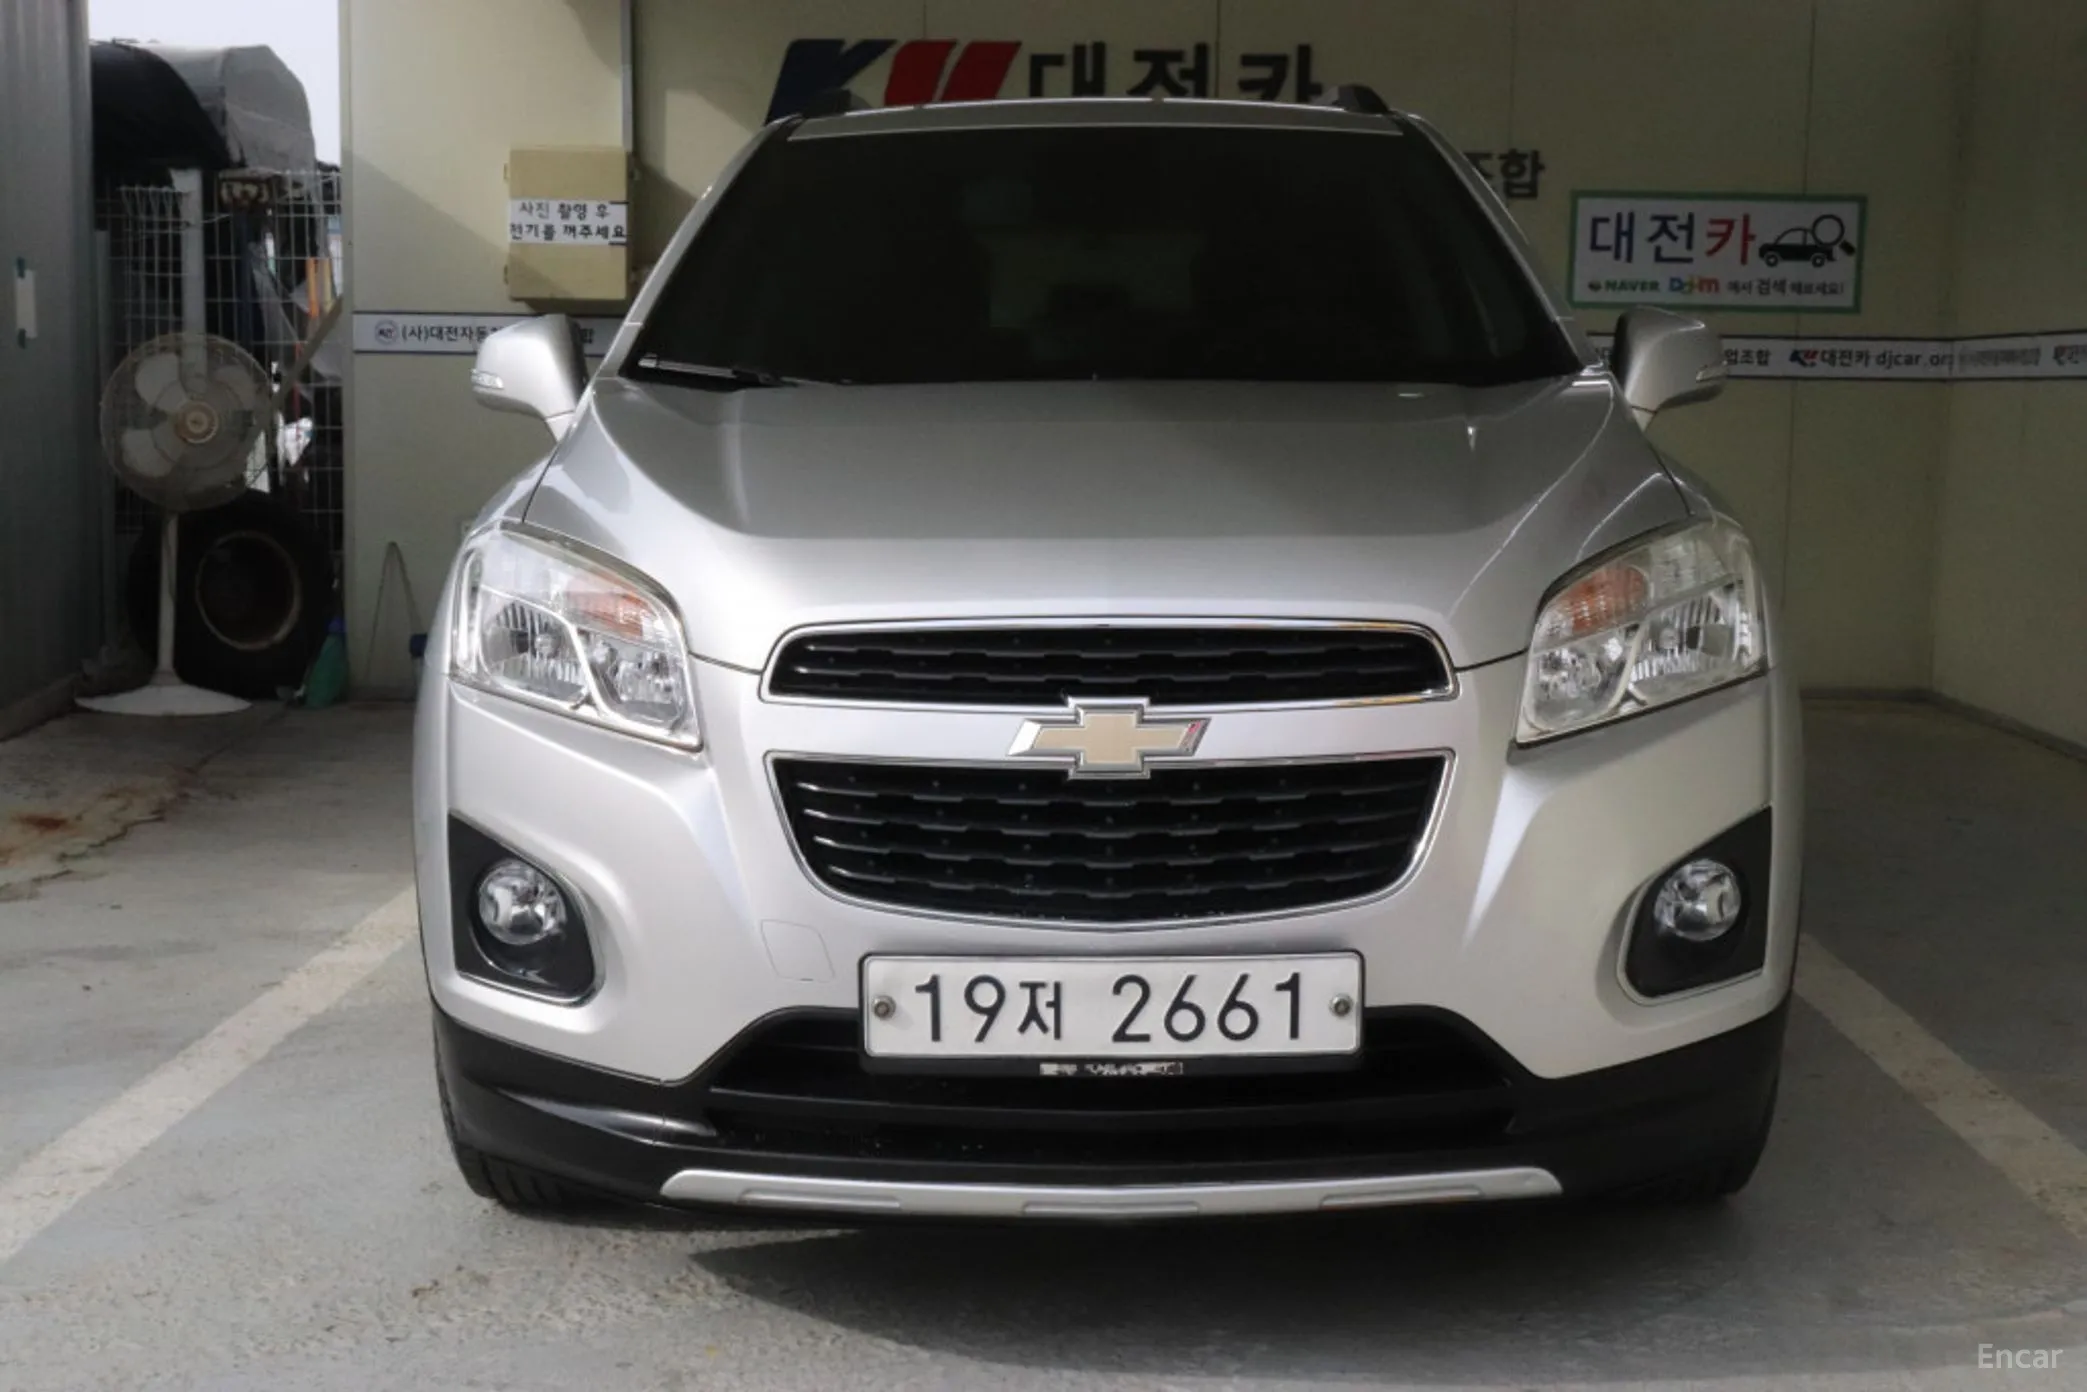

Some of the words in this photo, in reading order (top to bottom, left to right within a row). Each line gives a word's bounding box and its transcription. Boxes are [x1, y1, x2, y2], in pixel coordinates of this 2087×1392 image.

[520, 202, 549, 219] 사진
[510, 223, 555, 241] 전기를
[563, 224, 626, 240] 꺼주세요
[1590, 211, 1756, 266] 대전카
[1605, 279, 1660, 292] NAVER
[1757, 277, 1787, 296] 검색
[915, 974, 1062, 1043] 19저
[1112, 972, 1302, 1043] 2661
